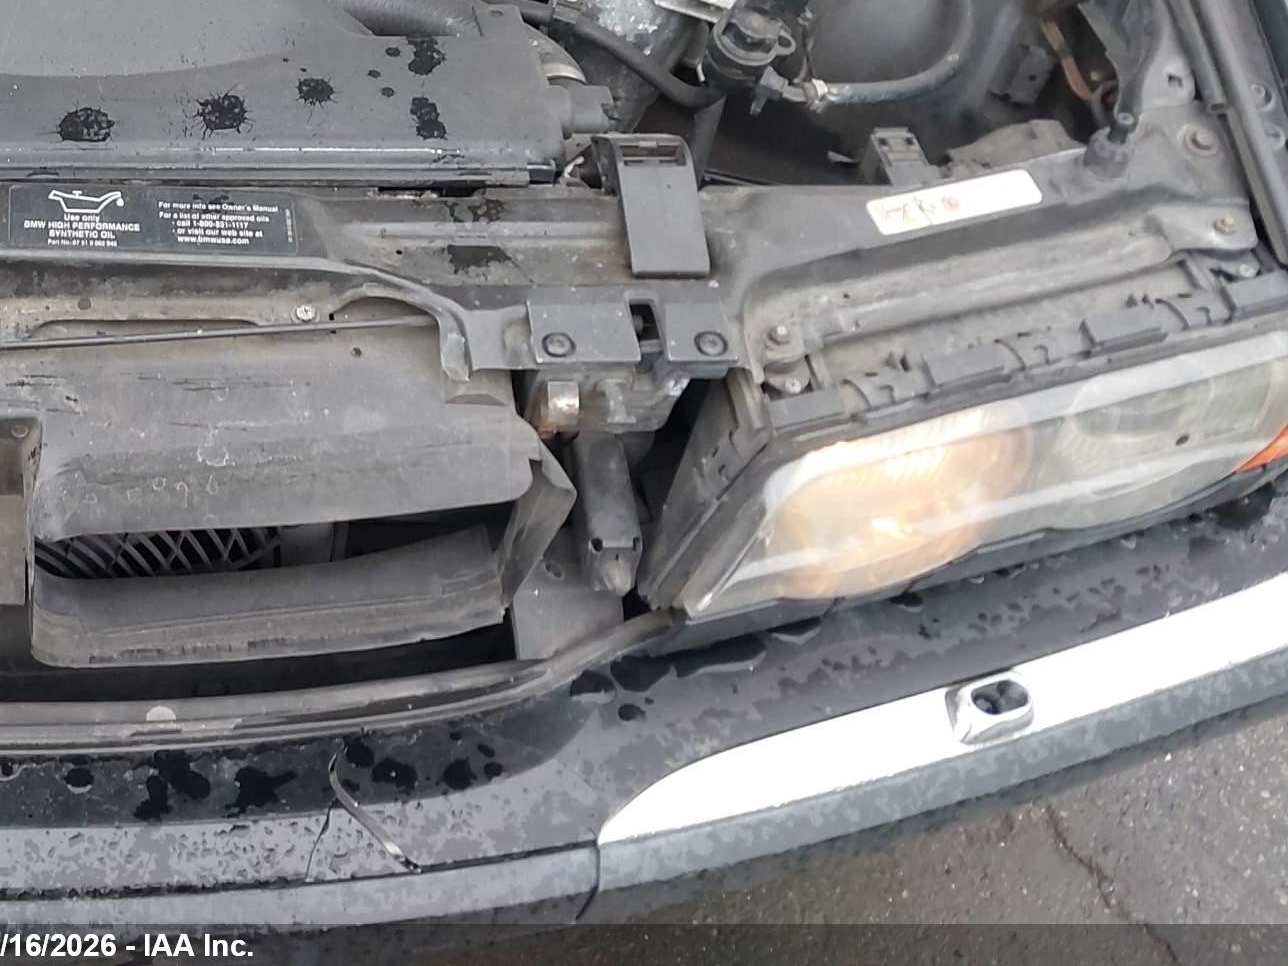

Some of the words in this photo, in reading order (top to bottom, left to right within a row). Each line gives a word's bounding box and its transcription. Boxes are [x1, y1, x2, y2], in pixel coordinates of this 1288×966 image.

[158, 201, 171, 209] For
[192, 202, 206, 210] info
[222, 203, 251, 211] Owner's
[253, 204, 279, 212] Manual
[63, 213, 80, 222] Use
[82, 214, 100, 223] only
[159, 211, 171, 219] For
[179, 212, 190, 220] list
[191, 212, 200, 220] of
[201, 212, 220, 220] other
[221, 213, 255, 223] approved
[24, 220, 46, 229] BMW
[48, 221, 71, 229] HIGH
[72, 221, 140, 232] PERFORMANCE
[193, 220, 248, 229] 1-800-831-1117
[49, 229, 98, 238] SYNTHETIC
[100, 230, 115, 239] OIL
[177, 236, 250, 245] www.bmwusa.com
